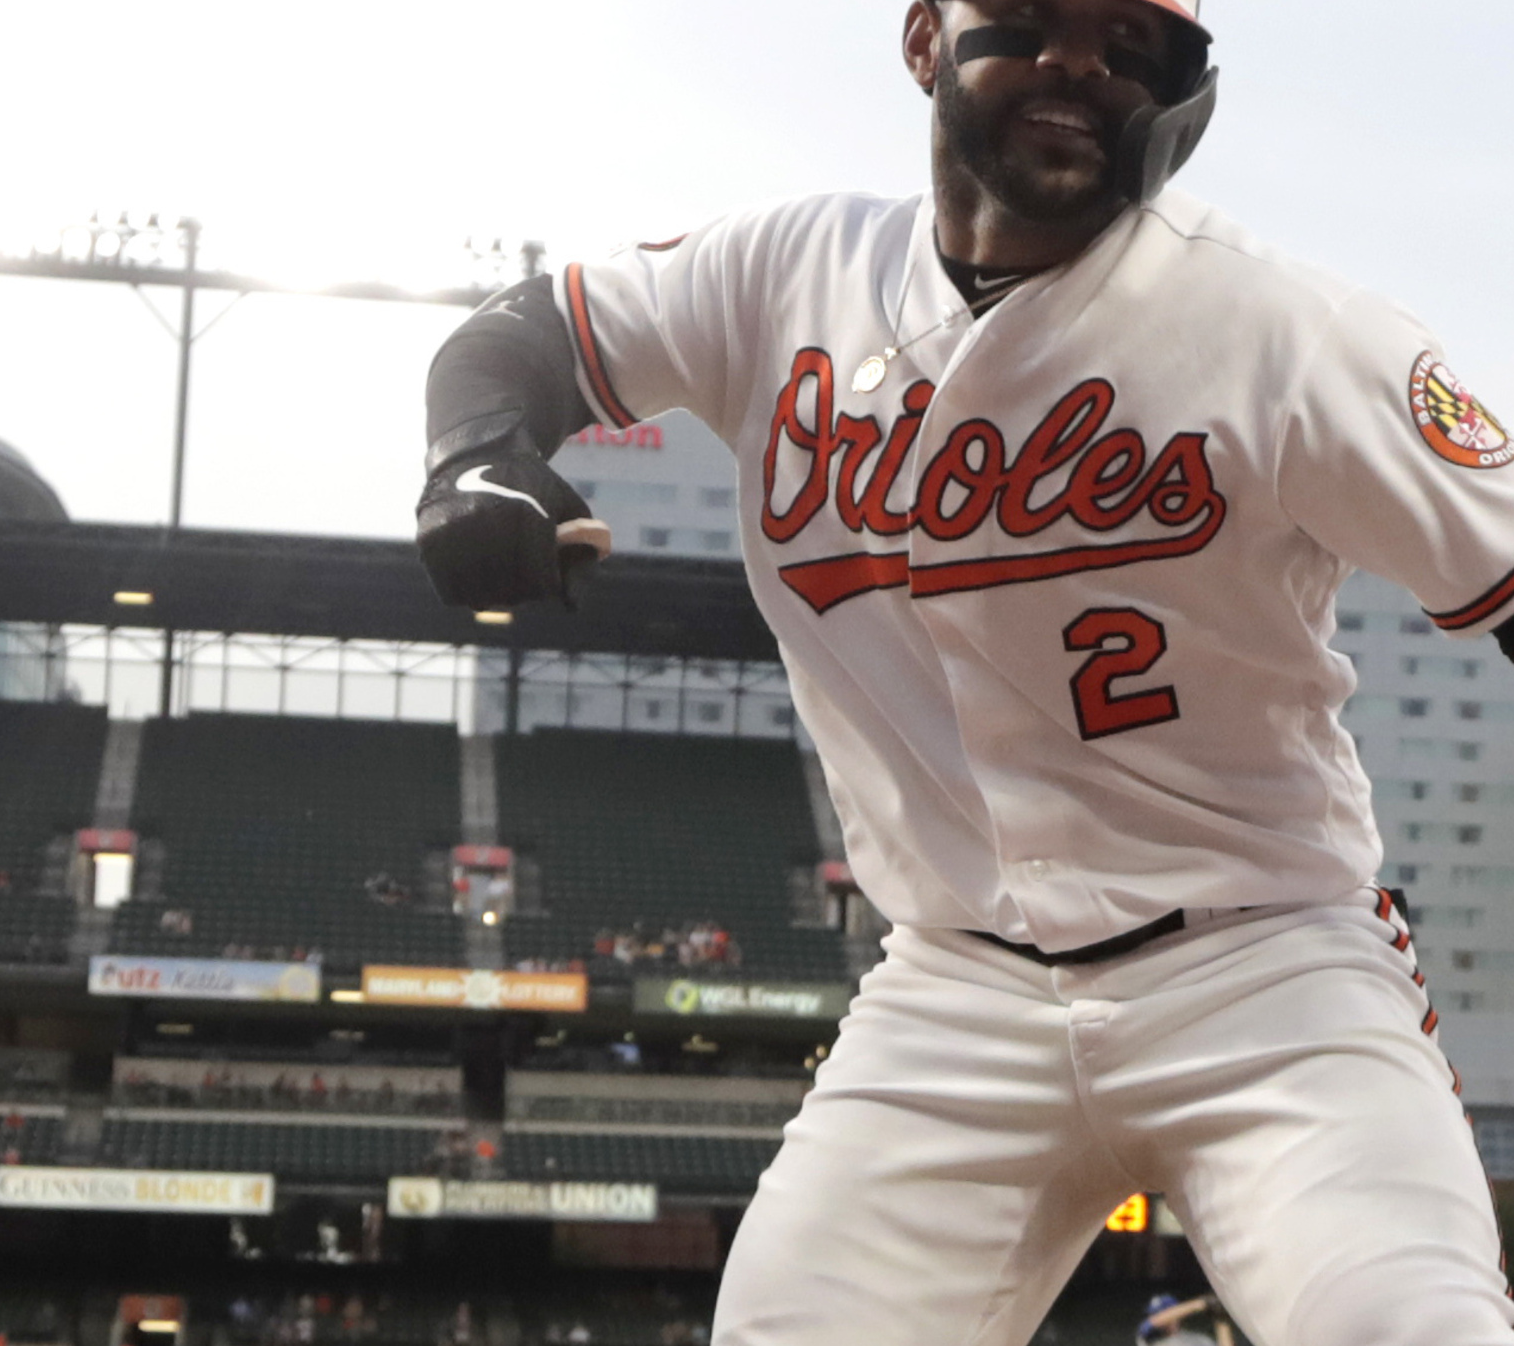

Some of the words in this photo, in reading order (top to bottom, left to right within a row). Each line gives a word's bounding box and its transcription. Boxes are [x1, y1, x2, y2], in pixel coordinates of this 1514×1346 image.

[761, 346, 1225, 543] Orioles
[1063, 606, 1180, 741] 2
[136, 1178, 232, 1203] BLONDE
[550, 1182, 656, 1215] UNION
